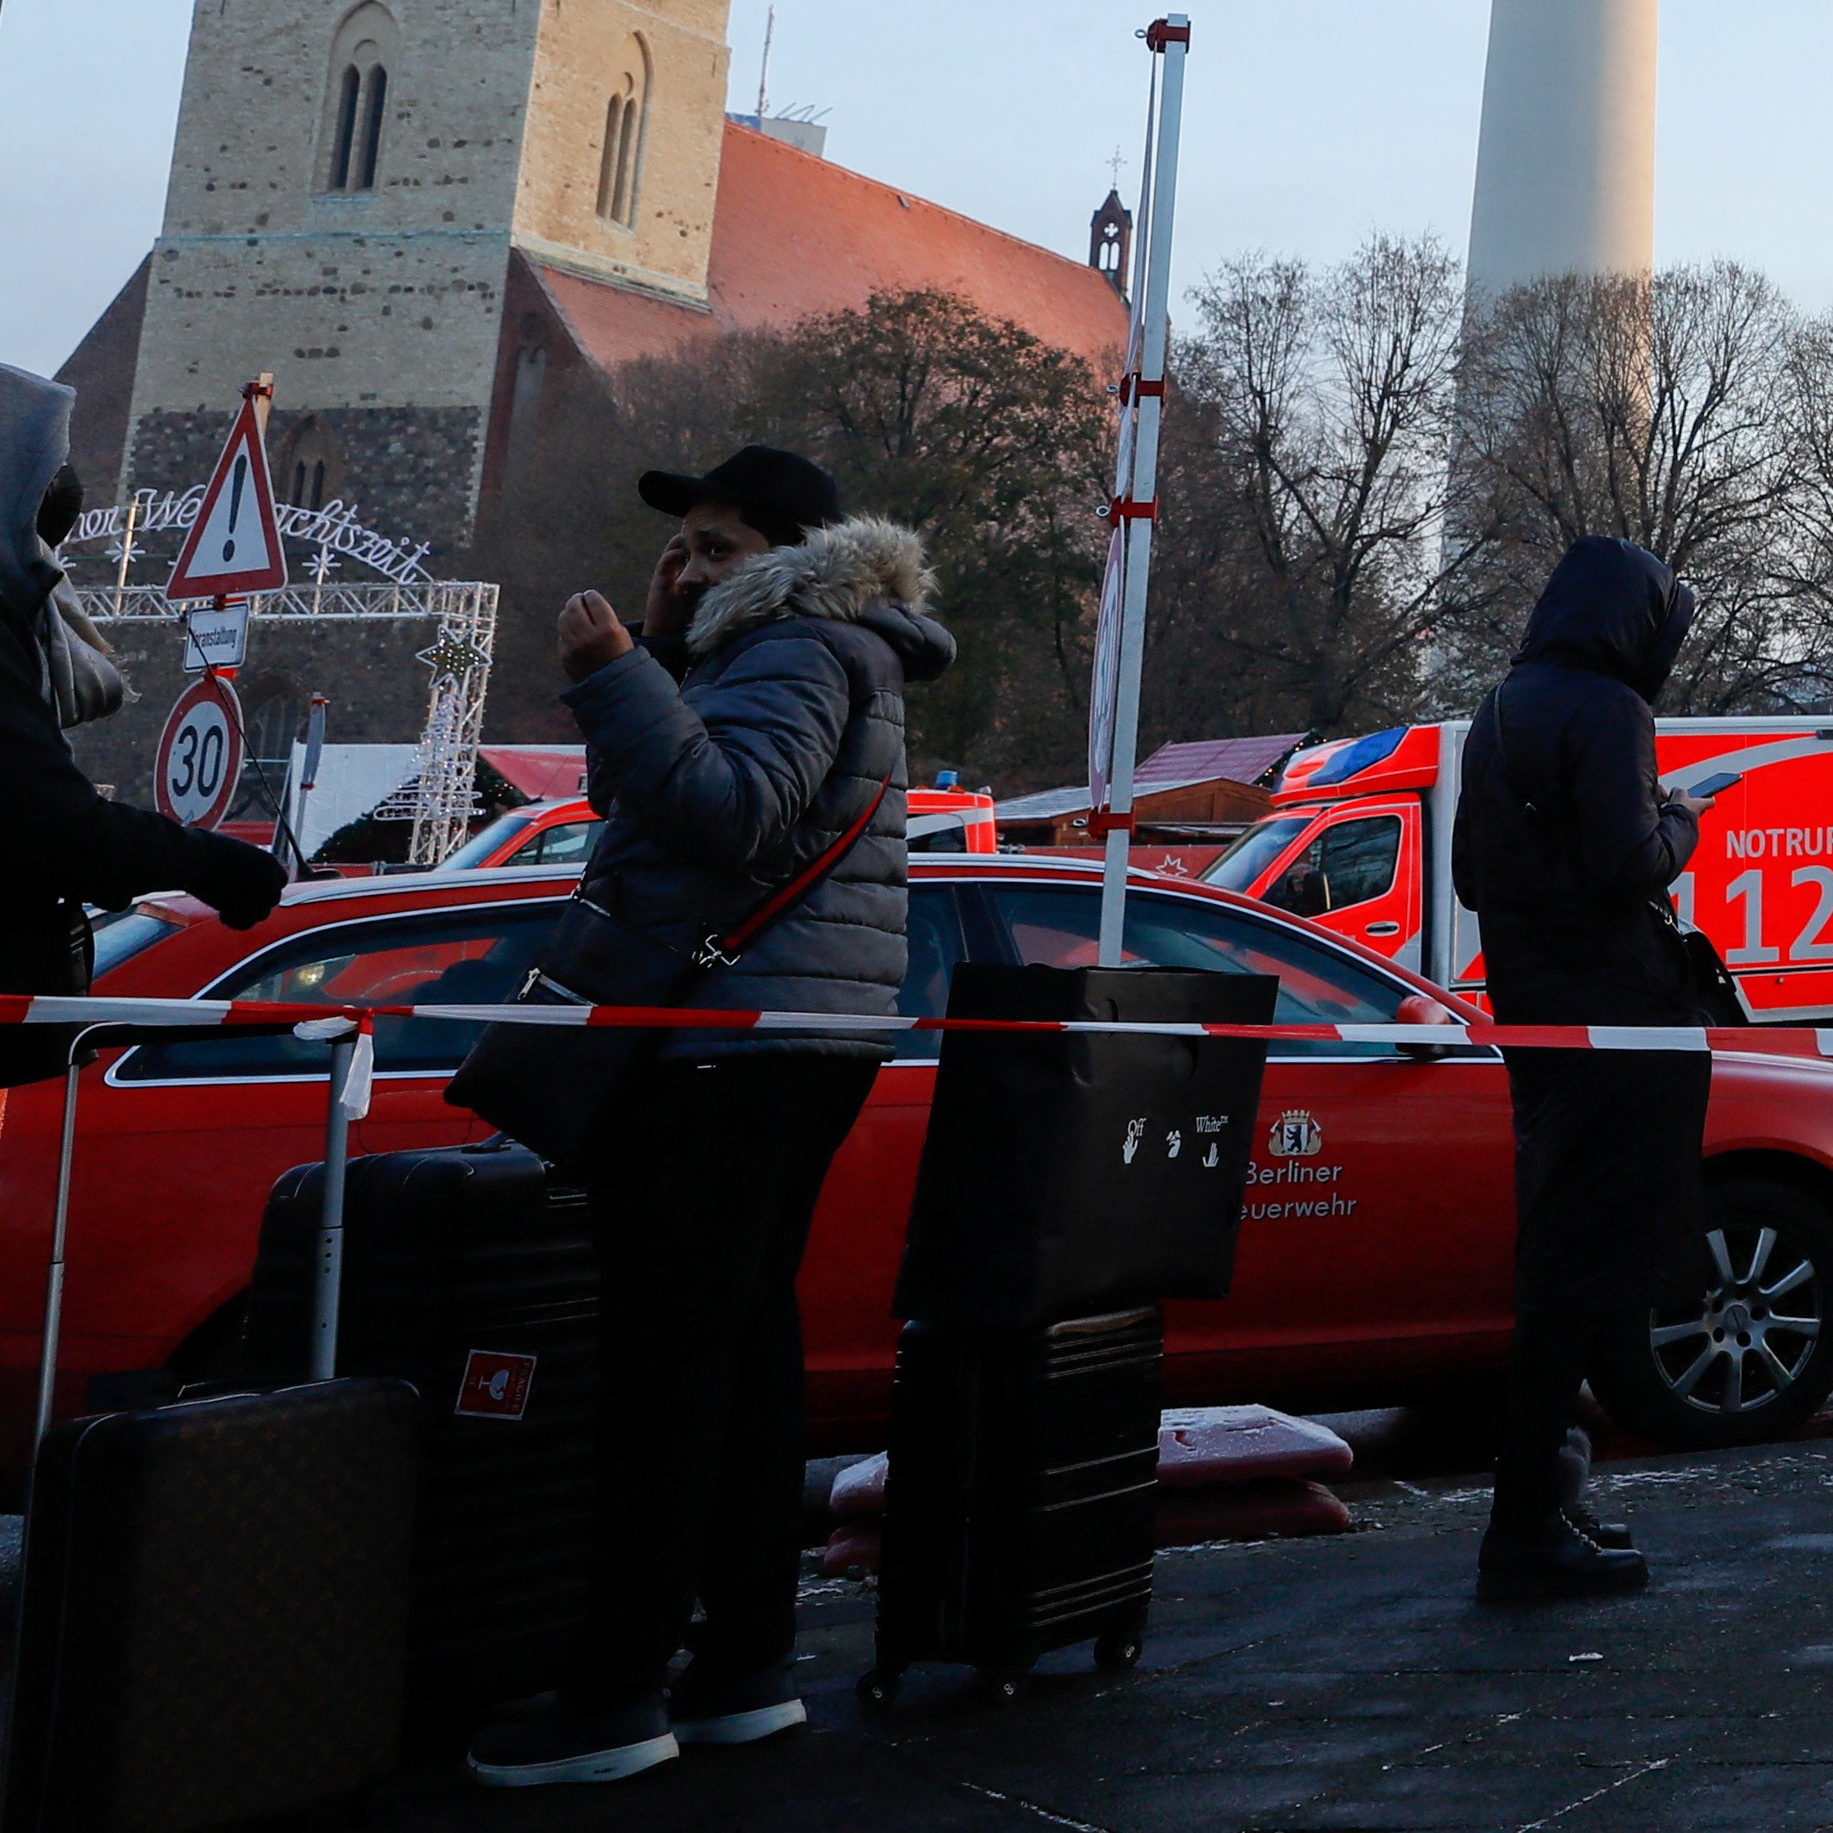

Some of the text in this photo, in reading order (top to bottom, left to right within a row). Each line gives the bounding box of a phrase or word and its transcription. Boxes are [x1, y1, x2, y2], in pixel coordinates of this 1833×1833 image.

[172, 724, 224, 798] 30
[1127, 1117, 1147, 1137] Off
[1245, 1159, 1343, 1185] Berliner
